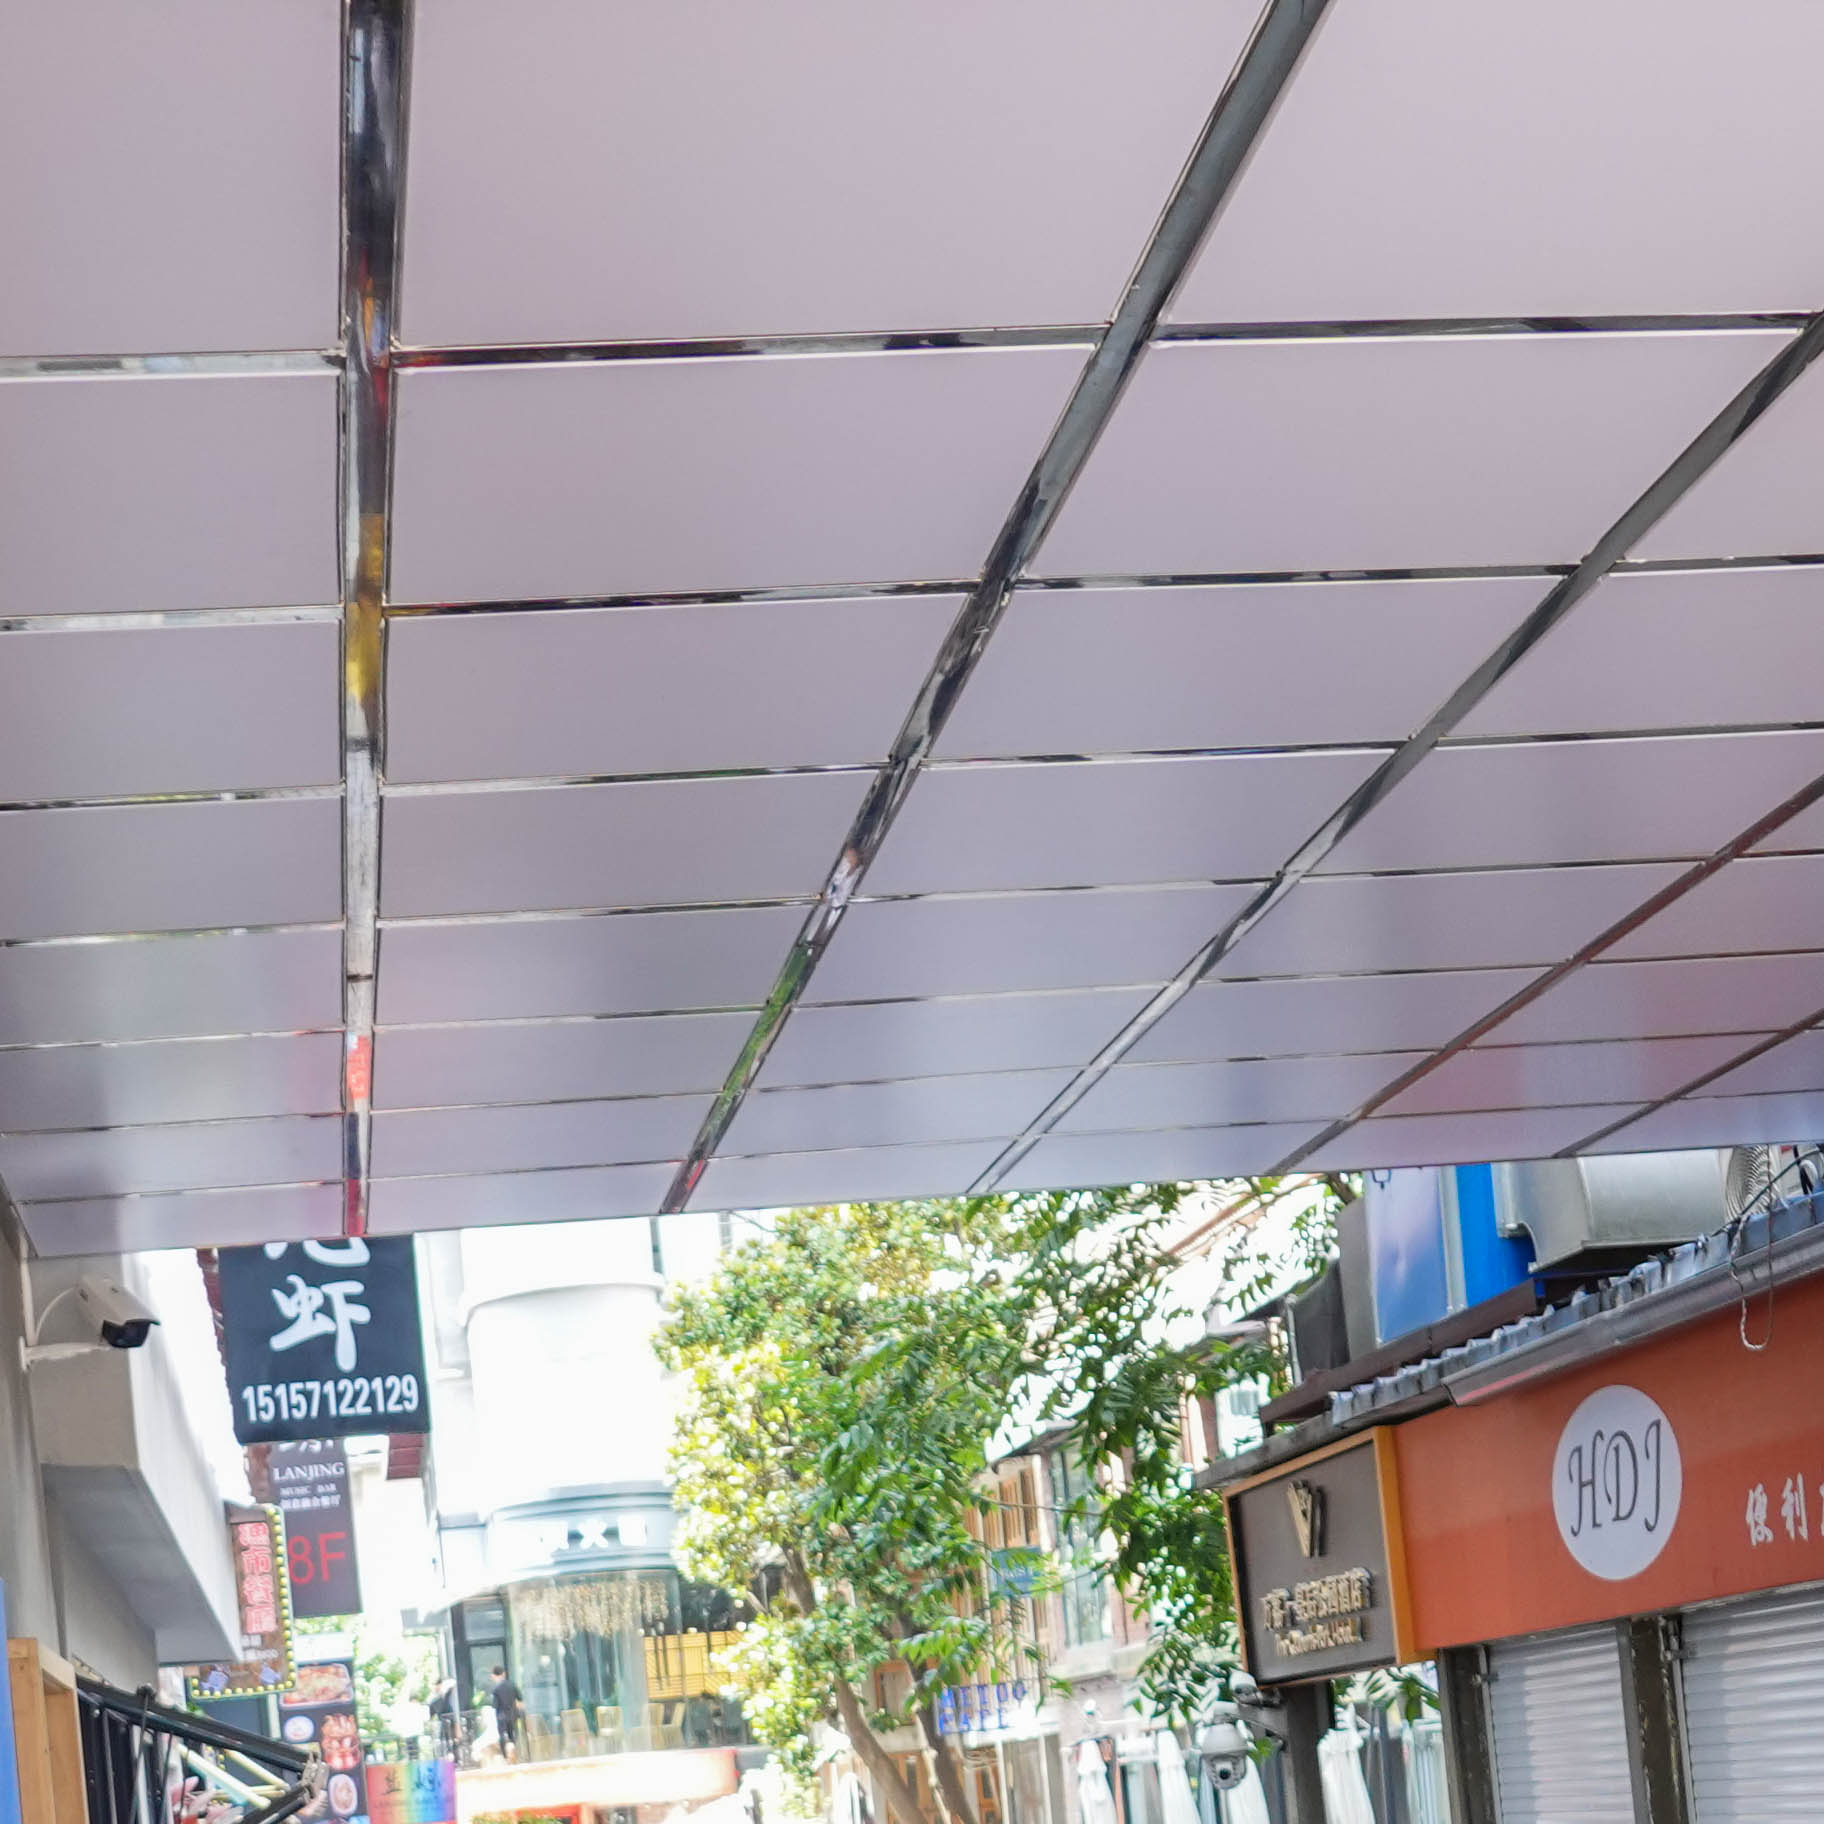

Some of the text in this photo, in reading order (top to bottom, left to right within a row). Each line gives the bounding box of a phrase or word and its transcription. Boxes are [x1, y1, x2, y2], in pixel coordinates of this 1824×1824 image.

[241, 1374, 419, 1422] 15157122129
[273, 1462, 345, 1482] LANJING
[287, 1531, 345, 1585] 8F
